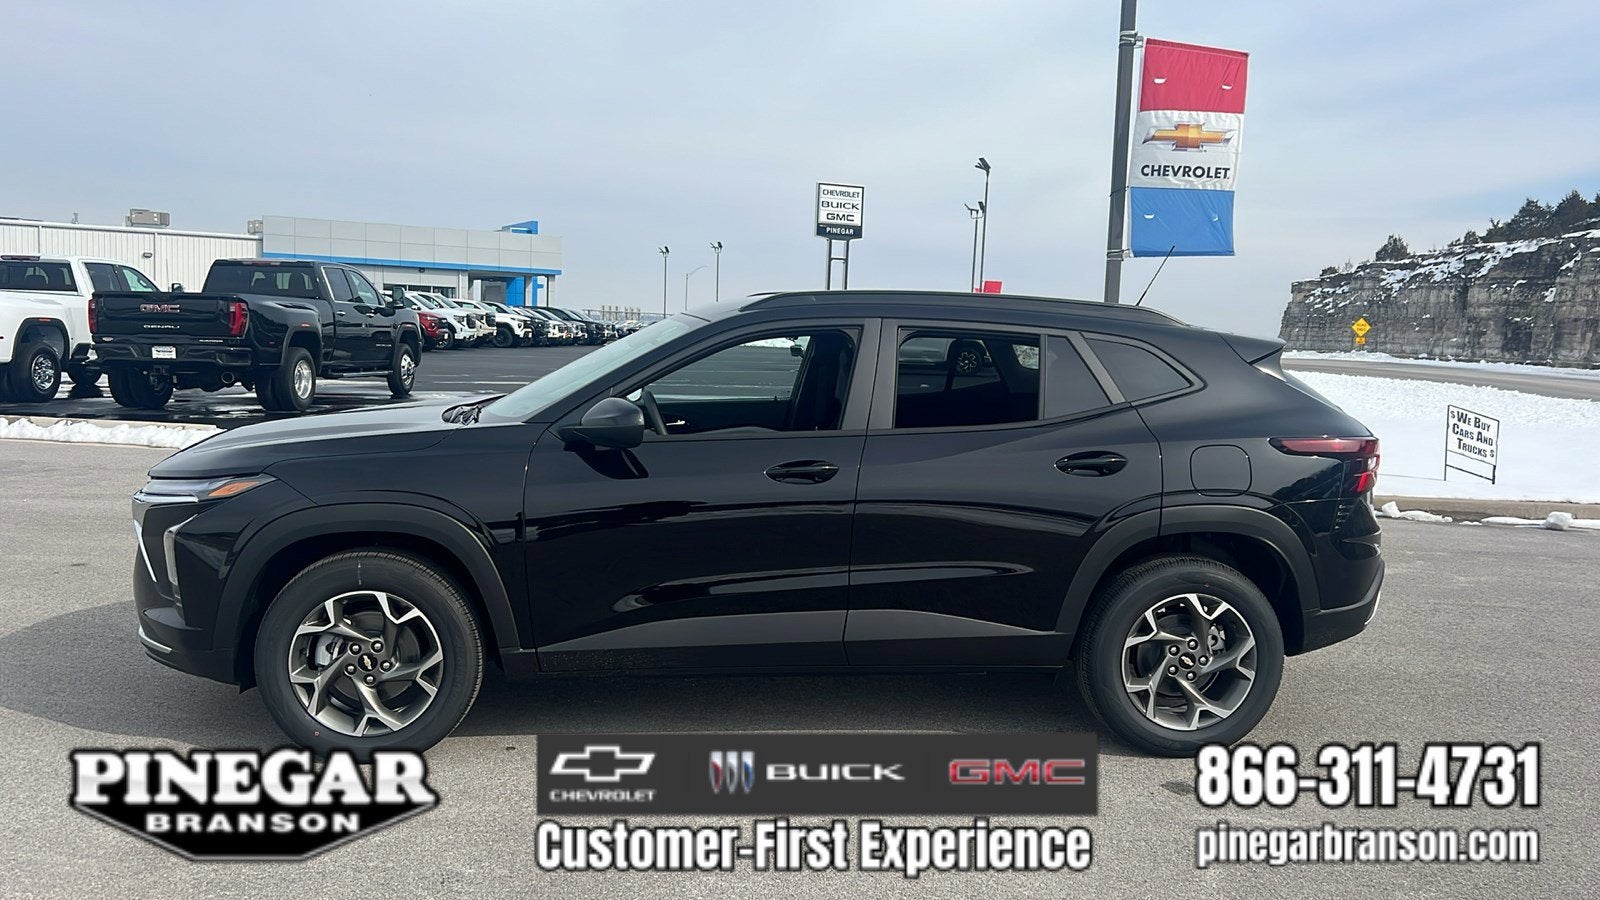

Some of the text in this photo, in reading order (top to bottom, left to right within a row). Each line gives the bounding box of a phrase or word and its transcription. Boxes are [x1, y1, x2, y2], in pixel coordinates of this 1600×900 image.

[1141, 164, 1230, 179] CHEVROLET
[822, 188, 860, 199] CHEVROLET
[821, 200, 860, 210] BUICK
[826, 212, 855, 222] GMC
[826, 227, 854, 235] PINEGAR
[139, 303, 180, 312] GMC
